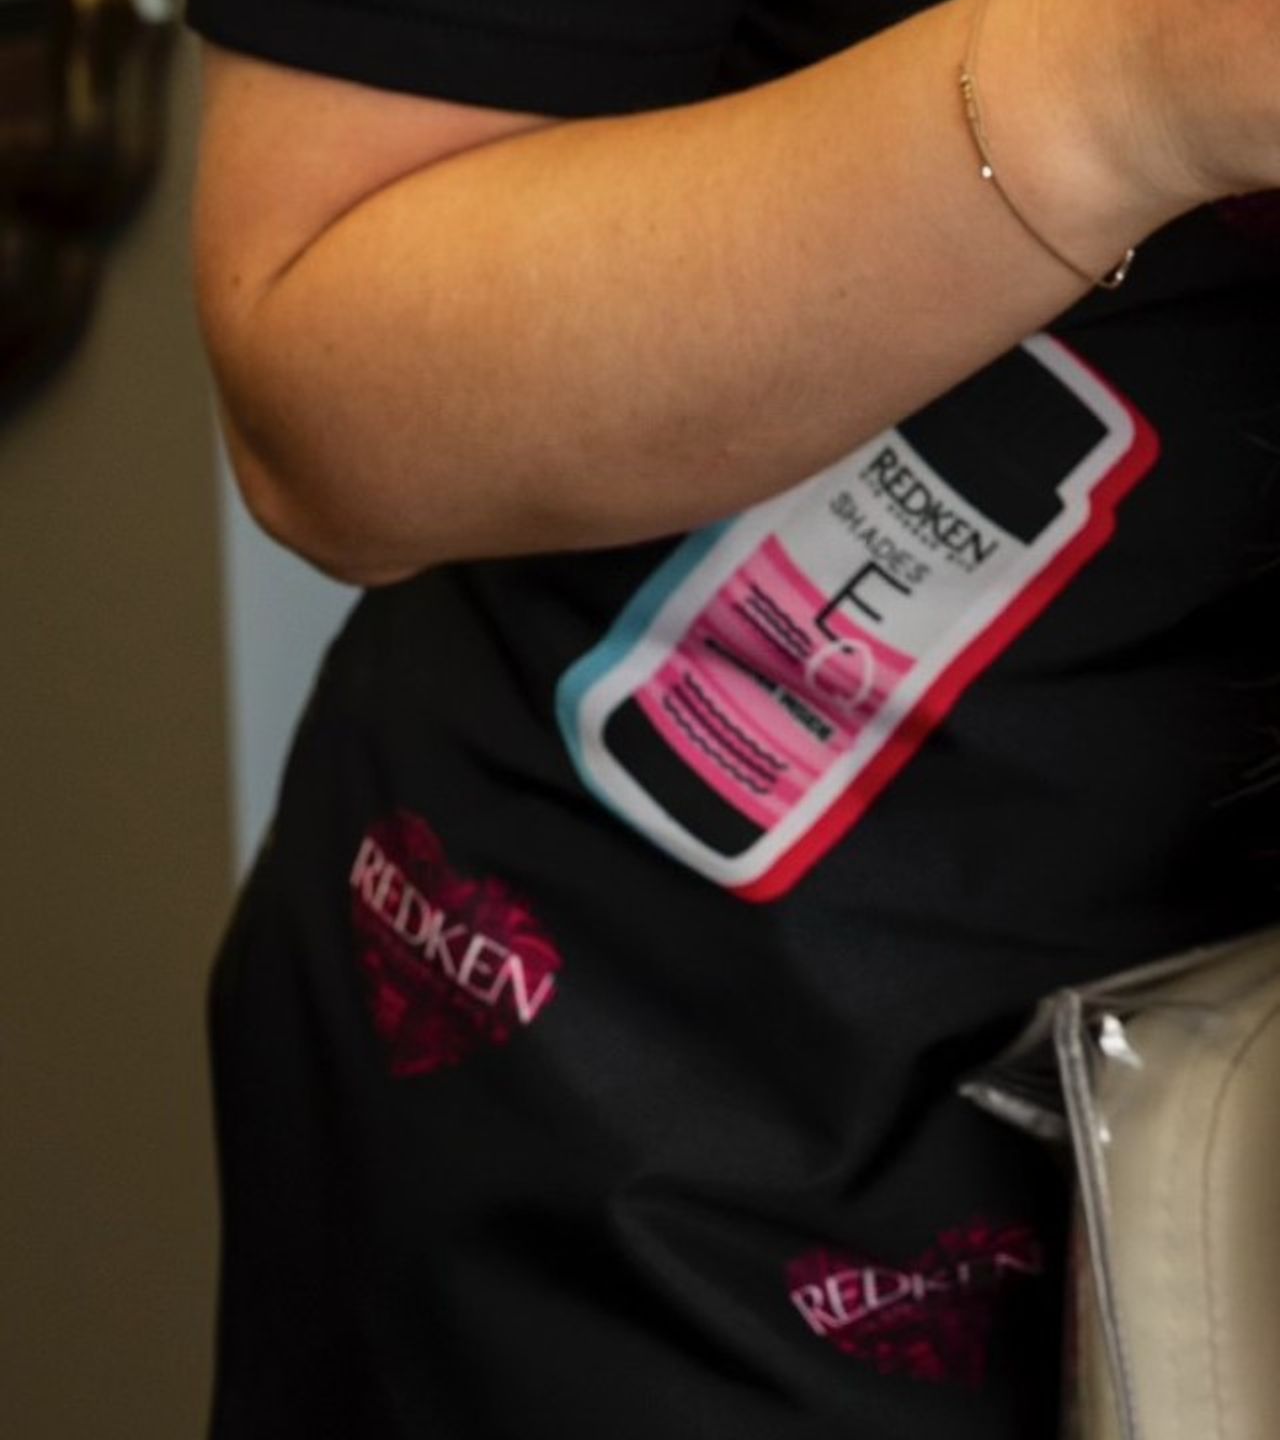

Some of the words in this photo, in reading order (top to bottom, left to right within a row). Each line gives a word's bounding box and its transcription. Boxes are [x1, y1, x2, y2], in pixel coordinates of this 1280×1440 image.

[829, 491, 932, 584] SHADES
[866, 446, 999, 564] REDKEN
[350, 834, 557, 1026] REDKEN
